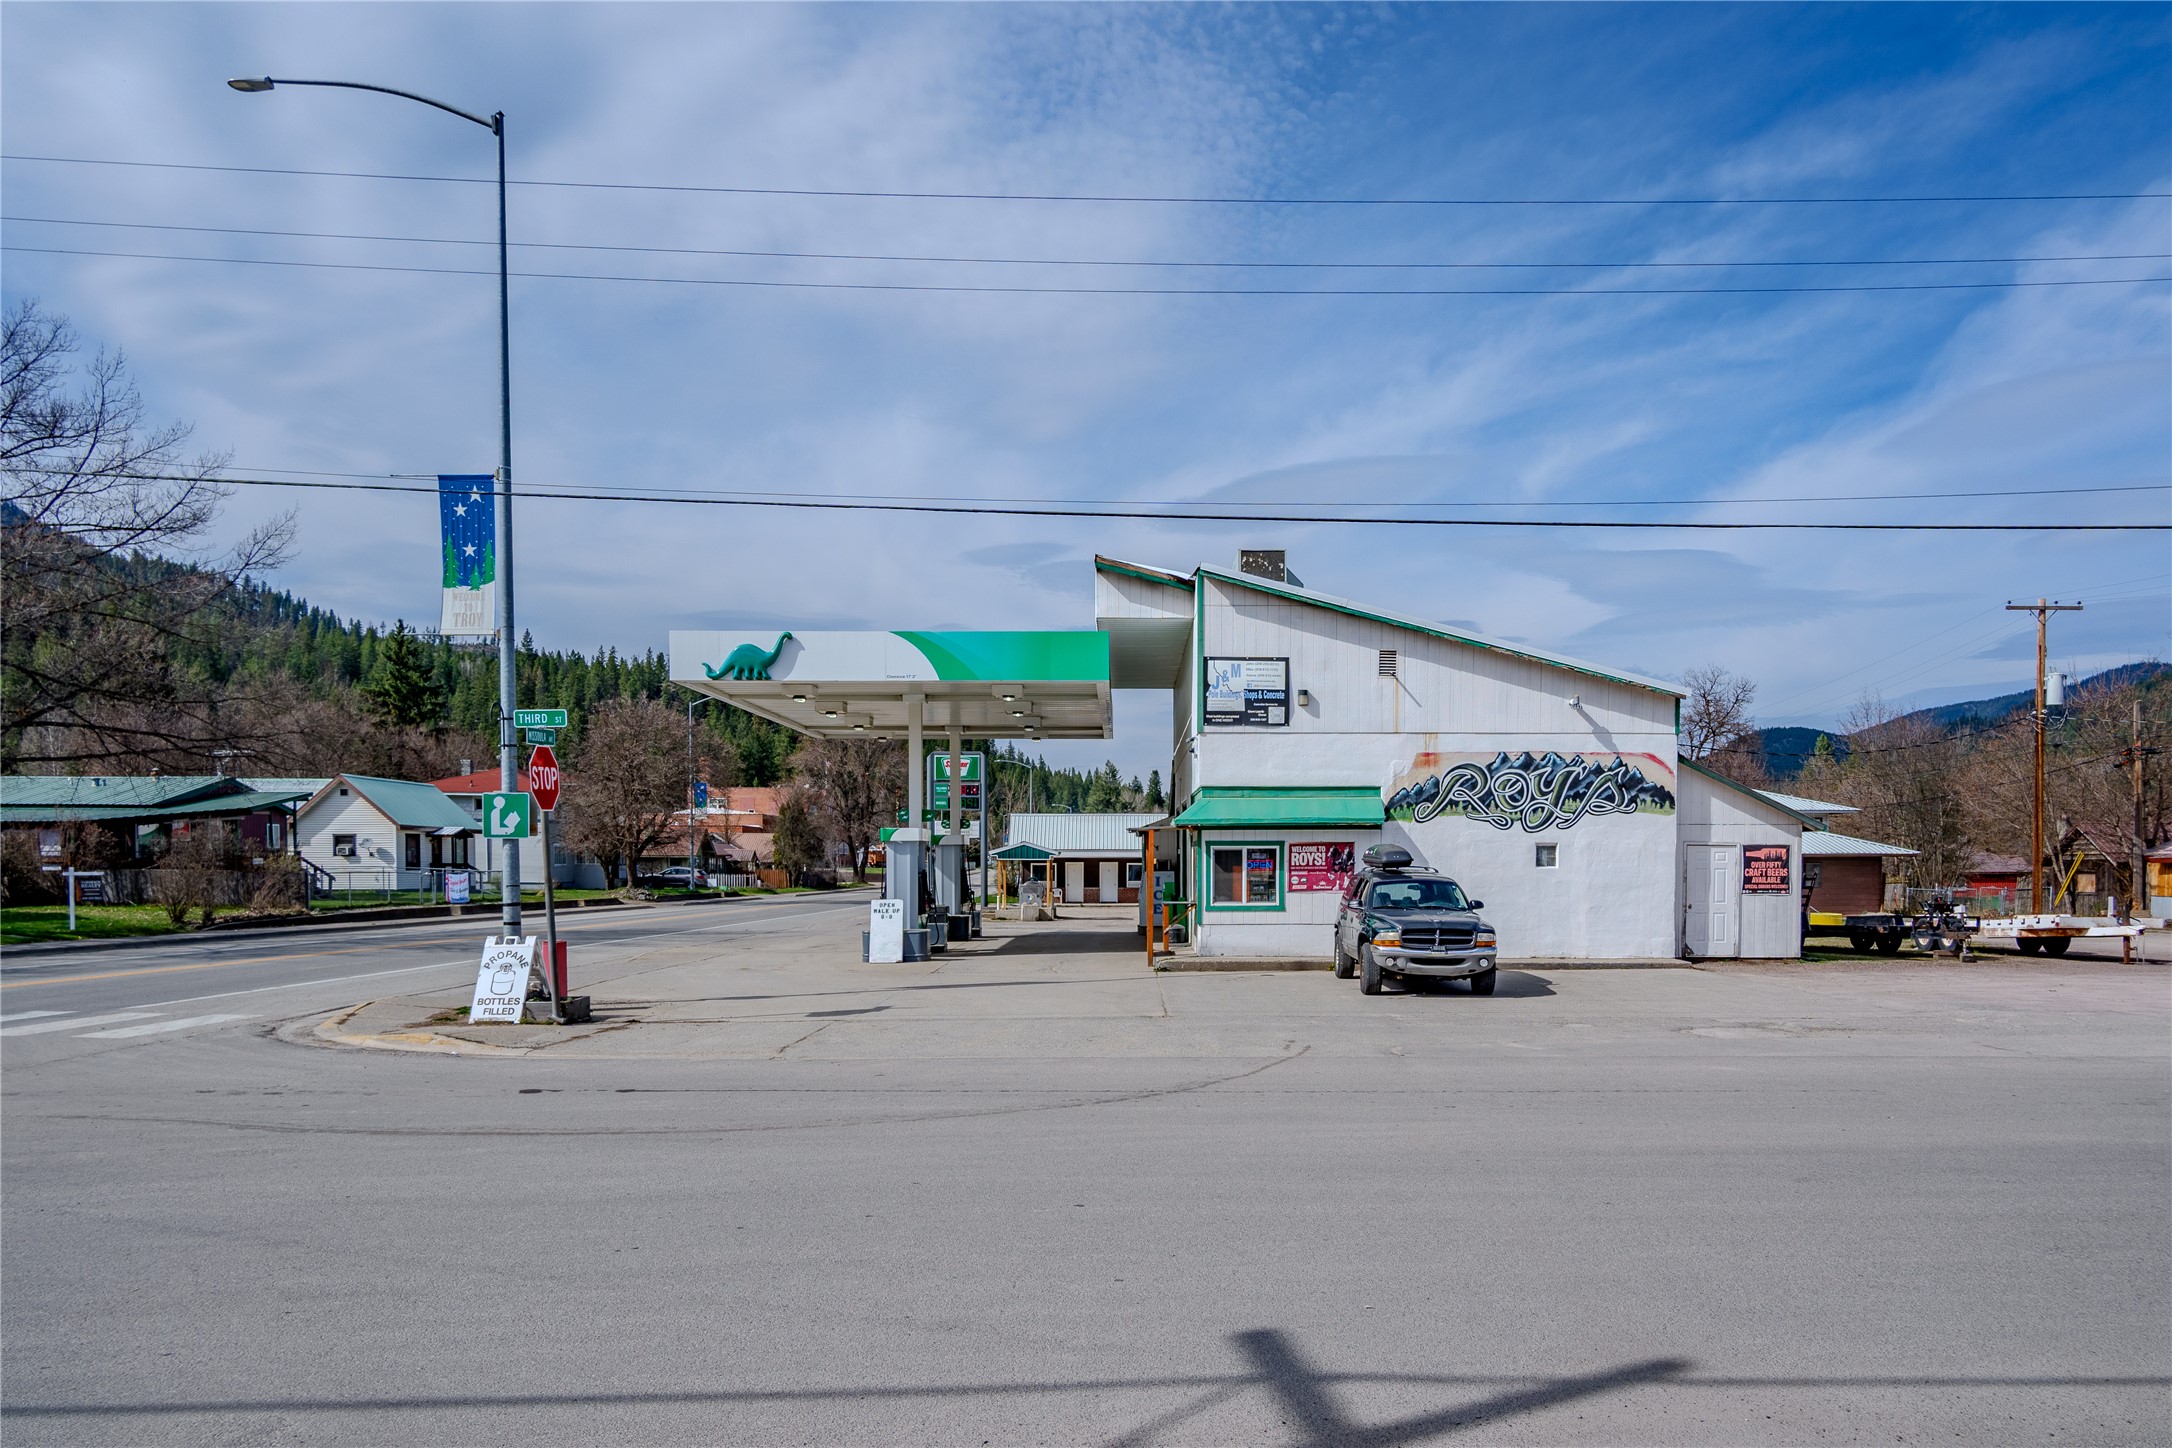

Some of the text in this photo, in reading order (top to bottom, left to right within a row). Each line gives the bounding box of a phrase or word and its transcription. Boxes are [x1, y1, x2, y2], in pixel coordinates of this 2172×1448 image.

[453, 592, 485, 601] WELCOME
[464, 603, 473, 612] TO
[453, 612, 484, 627] TROY
[1211, 663, 1241, 689] J & M
[1208, 690, 1219, 698] Pole
[1244, 689, 1257, 700] Shops
[1258, 690, 1262, 699] &
[1263, 690, 1285, 699] Concrete
[518, 713, 548, 724] THIRD
[531, 765, 558, 790] STOP
[1291, 852, 1326, 866] ROYS!
[1751, 861, 1766, 869] OVER
[1744, 868, 1788, 877] CRAFT BEERS
[1751, 876, 1781, 884] AVAILABLE
[1154, 876, 1163, 915] ICE
[483, 950, 530, 970] PROPANE
[477, 997, 521, 1006] BOTTLES
[483, 1007, 515, 1016] FILLED
